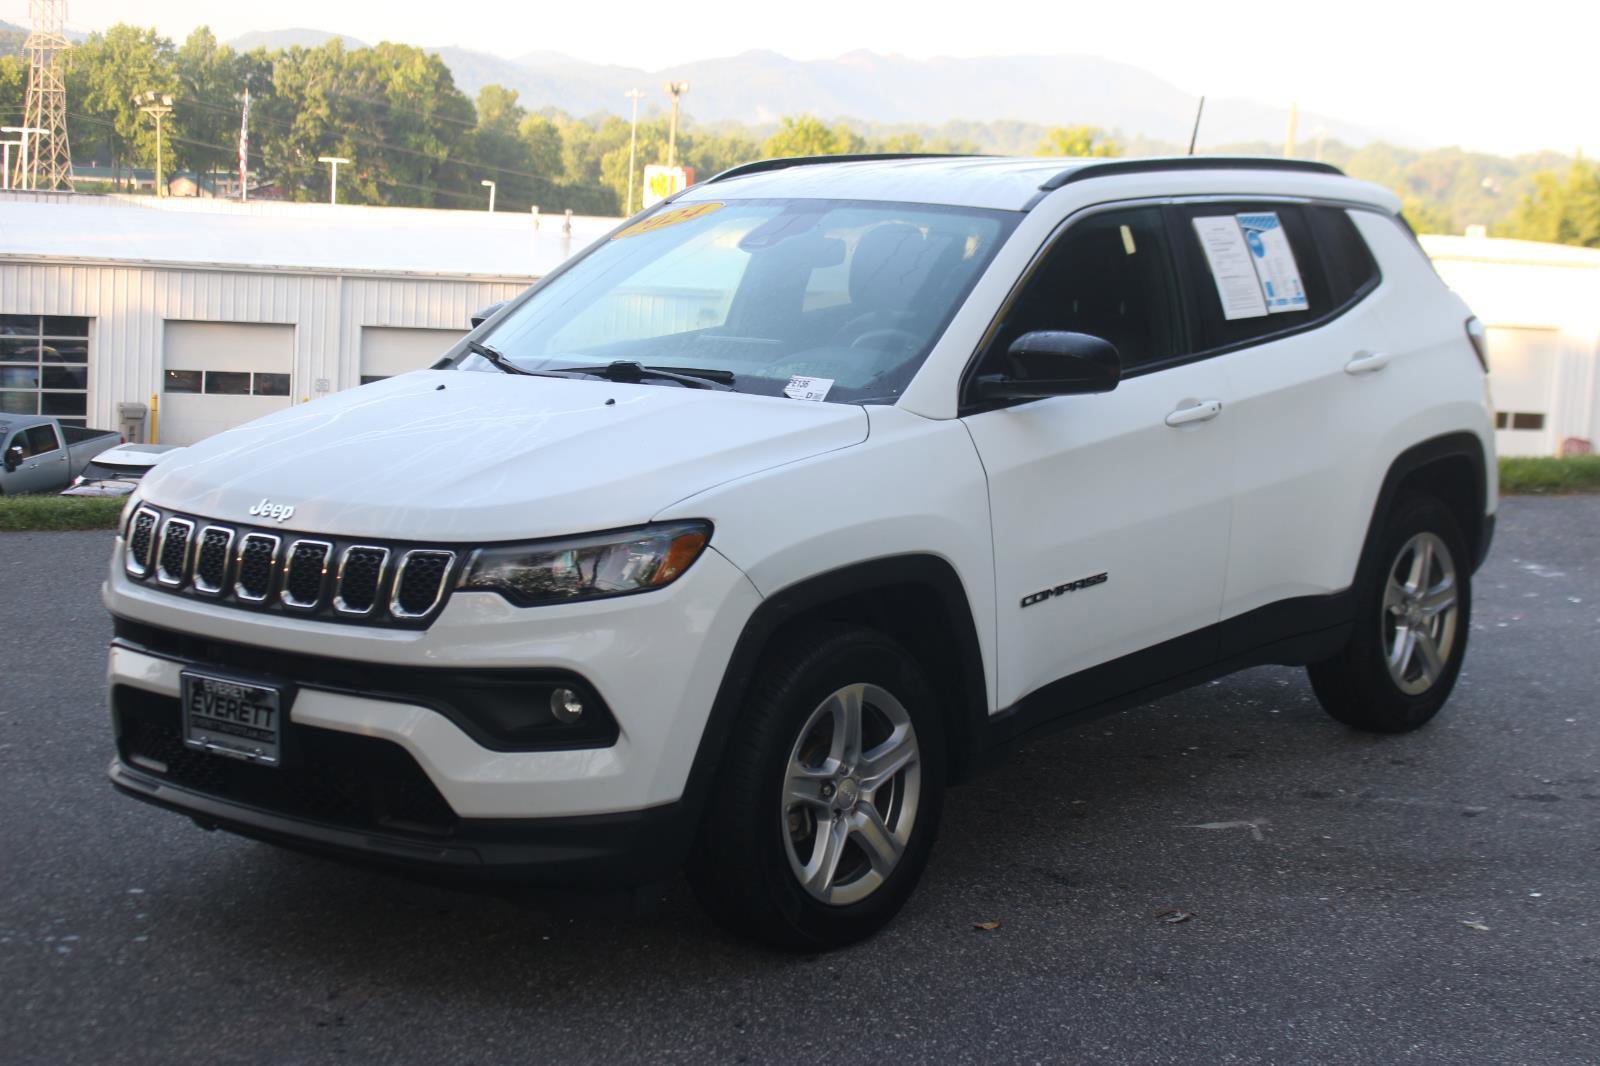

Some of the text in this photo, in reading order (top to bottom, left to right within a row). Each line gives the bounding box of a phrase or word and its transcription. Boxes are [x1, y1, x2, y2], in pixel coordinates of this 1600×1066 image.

[249, 498, 295, 522] Jeep
[1020, 571, 1108, 608] COMPASS
[192, 693, 275, 727] EVERETT
